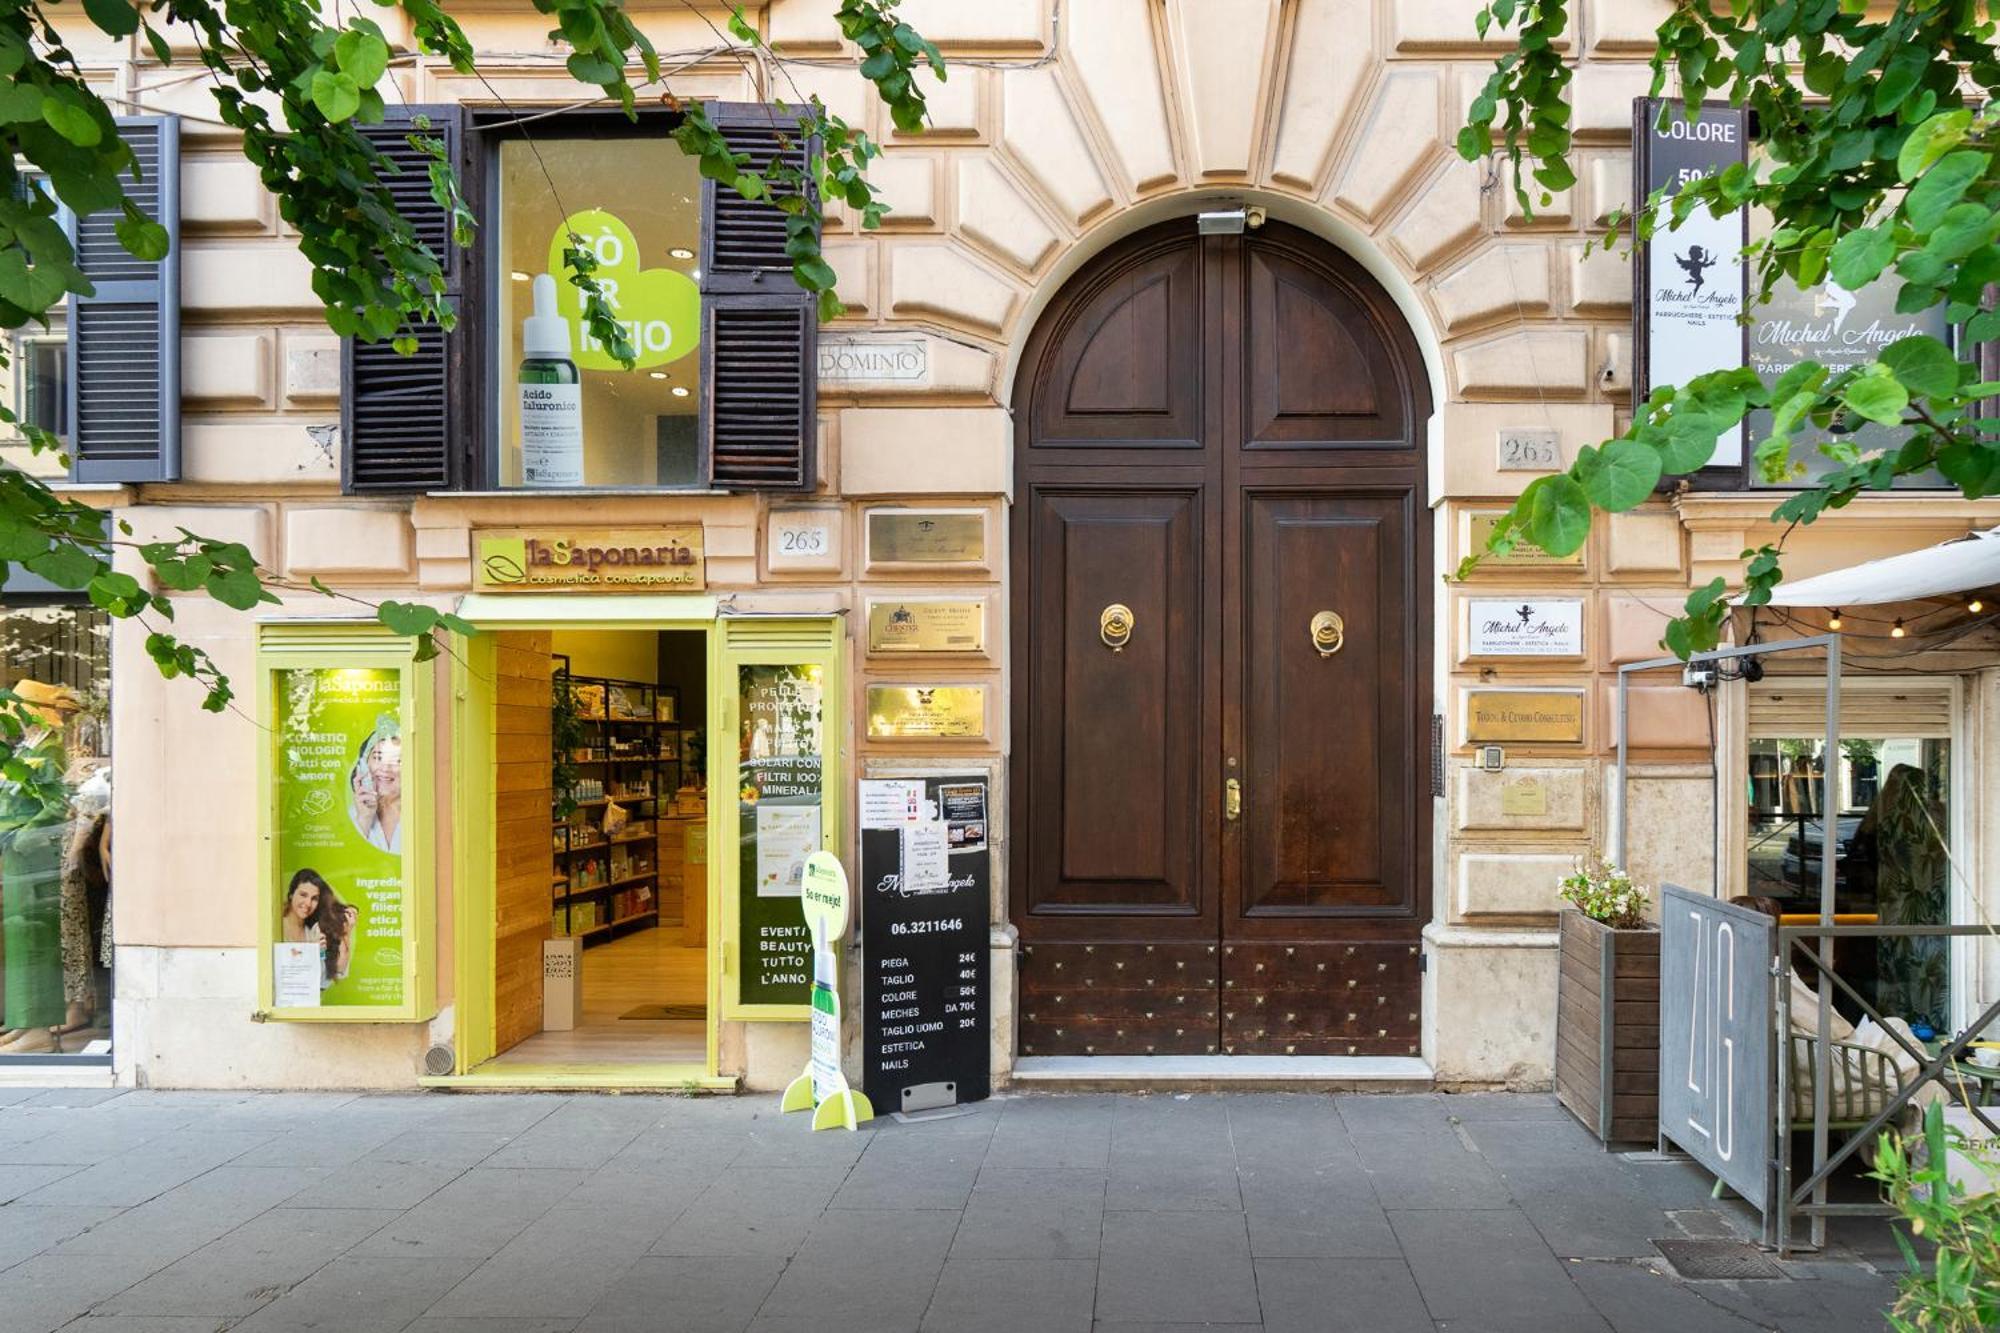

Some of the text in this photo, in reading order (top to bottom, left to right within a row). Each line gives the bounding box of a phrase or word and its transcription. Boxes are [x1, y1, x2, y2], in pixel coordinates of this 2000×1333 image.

[1656, 289, 1738, 307] Michel Angelo
[1758, 320, 1832, 346] Michel
[820, 353, 918, 370] DOMINIO
[523, 390, 552, 400] Acido
[1506, 438, 1553, 463] 265
[783, 530, 821, 551] 265
[527, 539, 697, 572] laSaponaria
[530, 573, 694, 586] cosmetica consapevole
[1482, 620, 1568, 637] Michel Angelo
[796, 759, 821, 769] CON
[756, 772, 791, 782] FILTRI
[762, 785, 818, 796] MINERALI
[760, 926, 807, 938] EVENTI
[891, 918, 963, 935] 06.3211646
[760, 941, 812, 953] BEAUTY
[761, 957, 804, 968] TUTTO
[881, 953, 976, 969] PIEGA 24€
[761, 973, 807, 985] L'ANNO
[881, 970, 976, 985] TAGLIO 40€
[881, 986, 976, 1003] COLORE 50€
[881, 1002, 976, 1020] MECHES DA 70€
[882, 1019, 976, 1037] TAGLIO UOMO 20€
[881, 1040, 925, 1054] ESTETICA
[881, 1059, 909, 1071] NAILS
